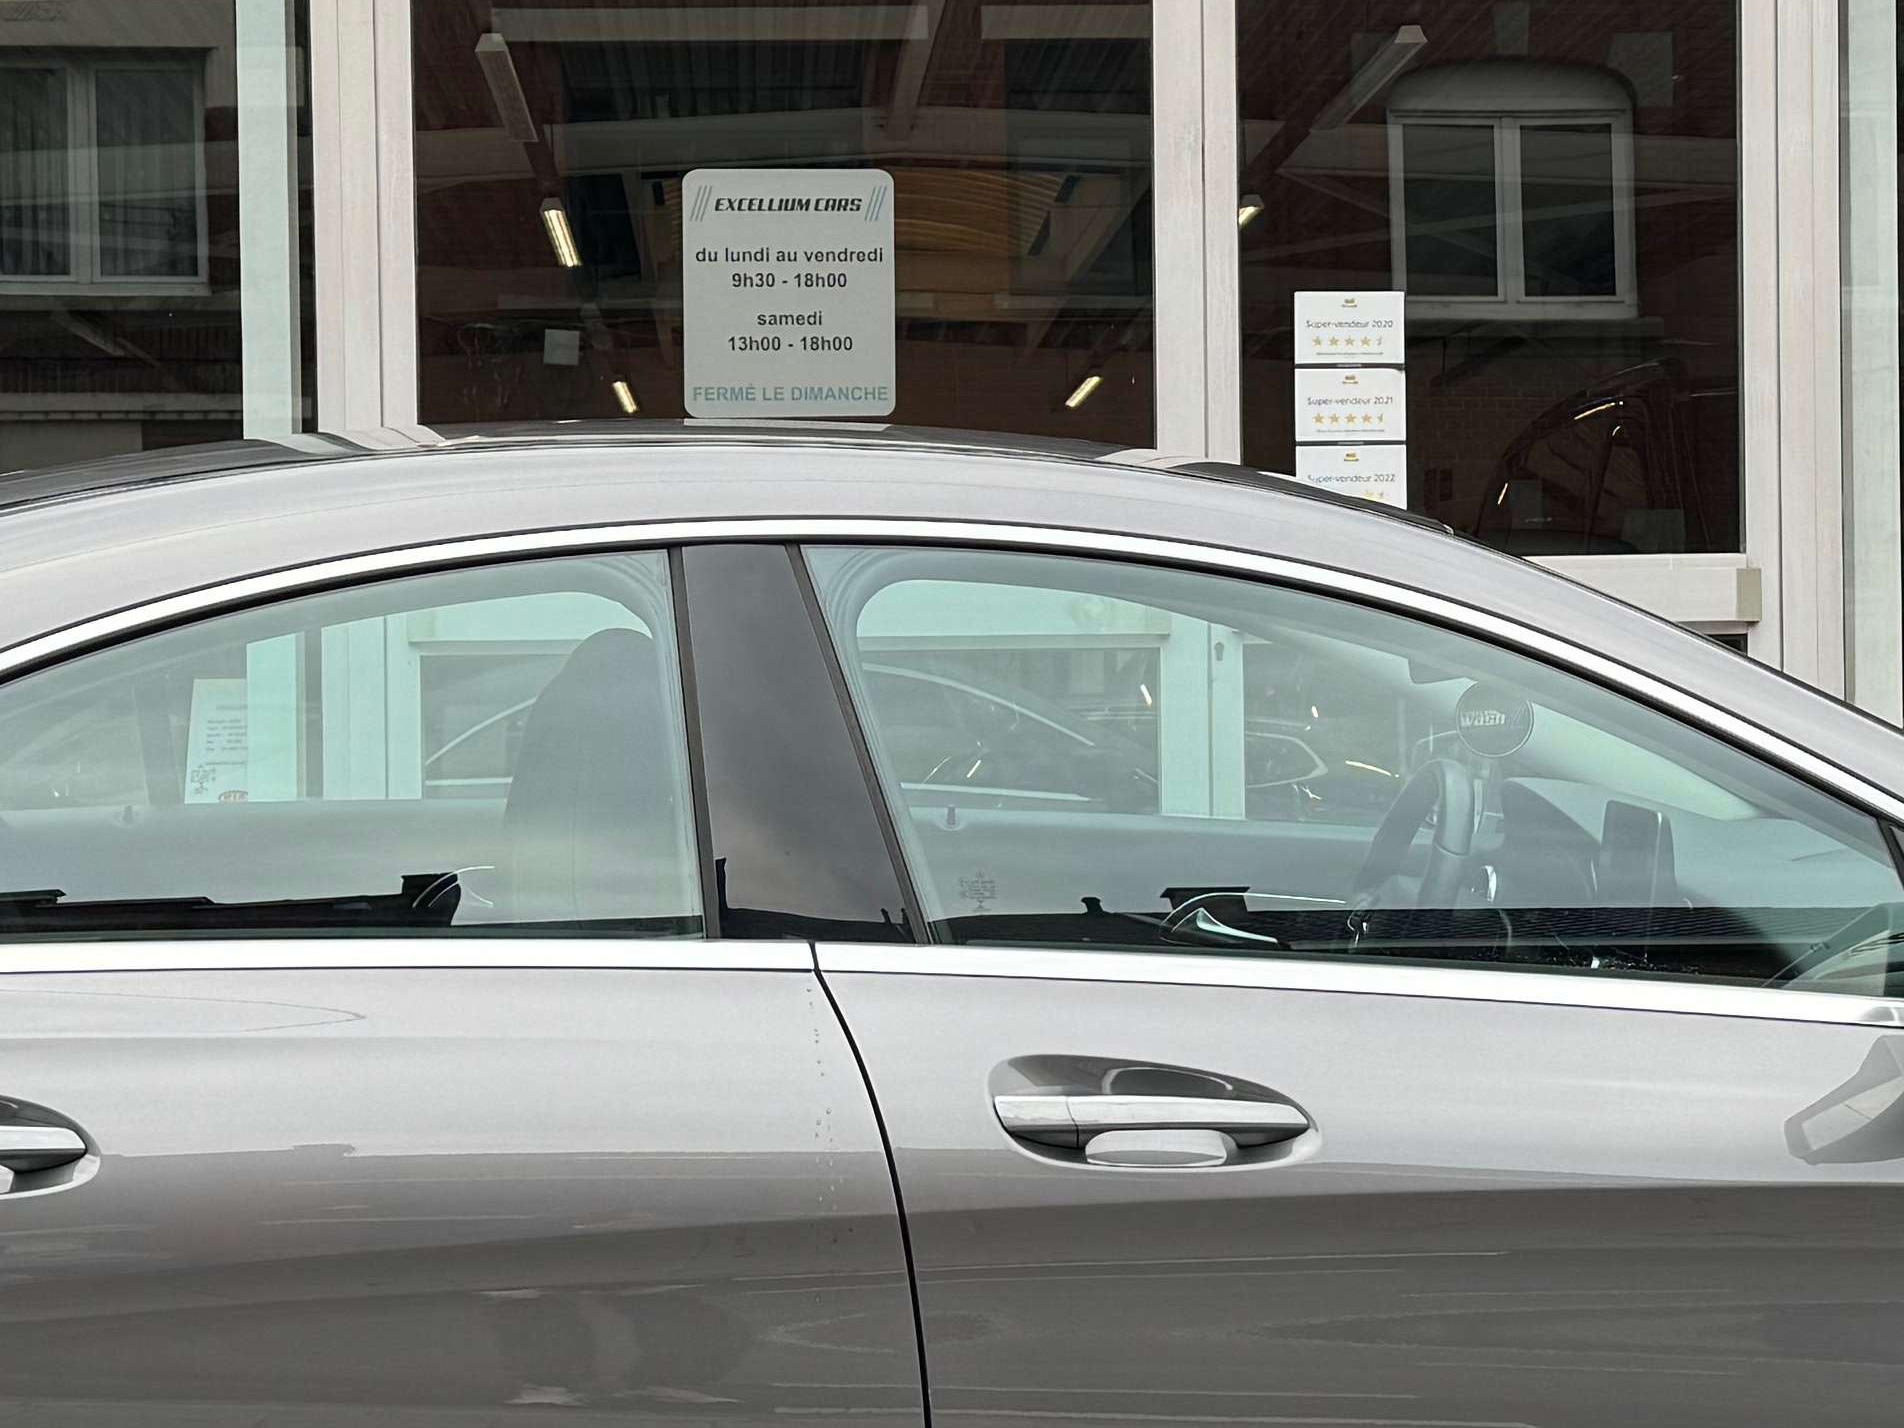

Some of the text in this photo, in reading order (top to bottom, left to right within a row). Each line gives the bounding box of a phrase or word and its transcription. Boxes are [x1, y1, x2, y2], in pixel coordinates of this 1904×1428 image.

[714, 198, 863, 212] EXCELLIUM CARS
[695, 247, 884, 263] du lundi au vendredi
[731, 273, 776, 288] 9h30
[793, 273, 848, 288] 18h00
[756, 311, 823, 326] samedi
[1306, 319, 1394, 330] Super-vendeur 2020
[727, 336, 781, 352] 13h00
[799, 336, 853, 352] 18h00
[692, 383, 889, 402] FERMÉ LE DIMANCHE
[1307, 396, 1394, 407] Super-vendeur 2021
[1373, 473, 1396, 483] 2022
